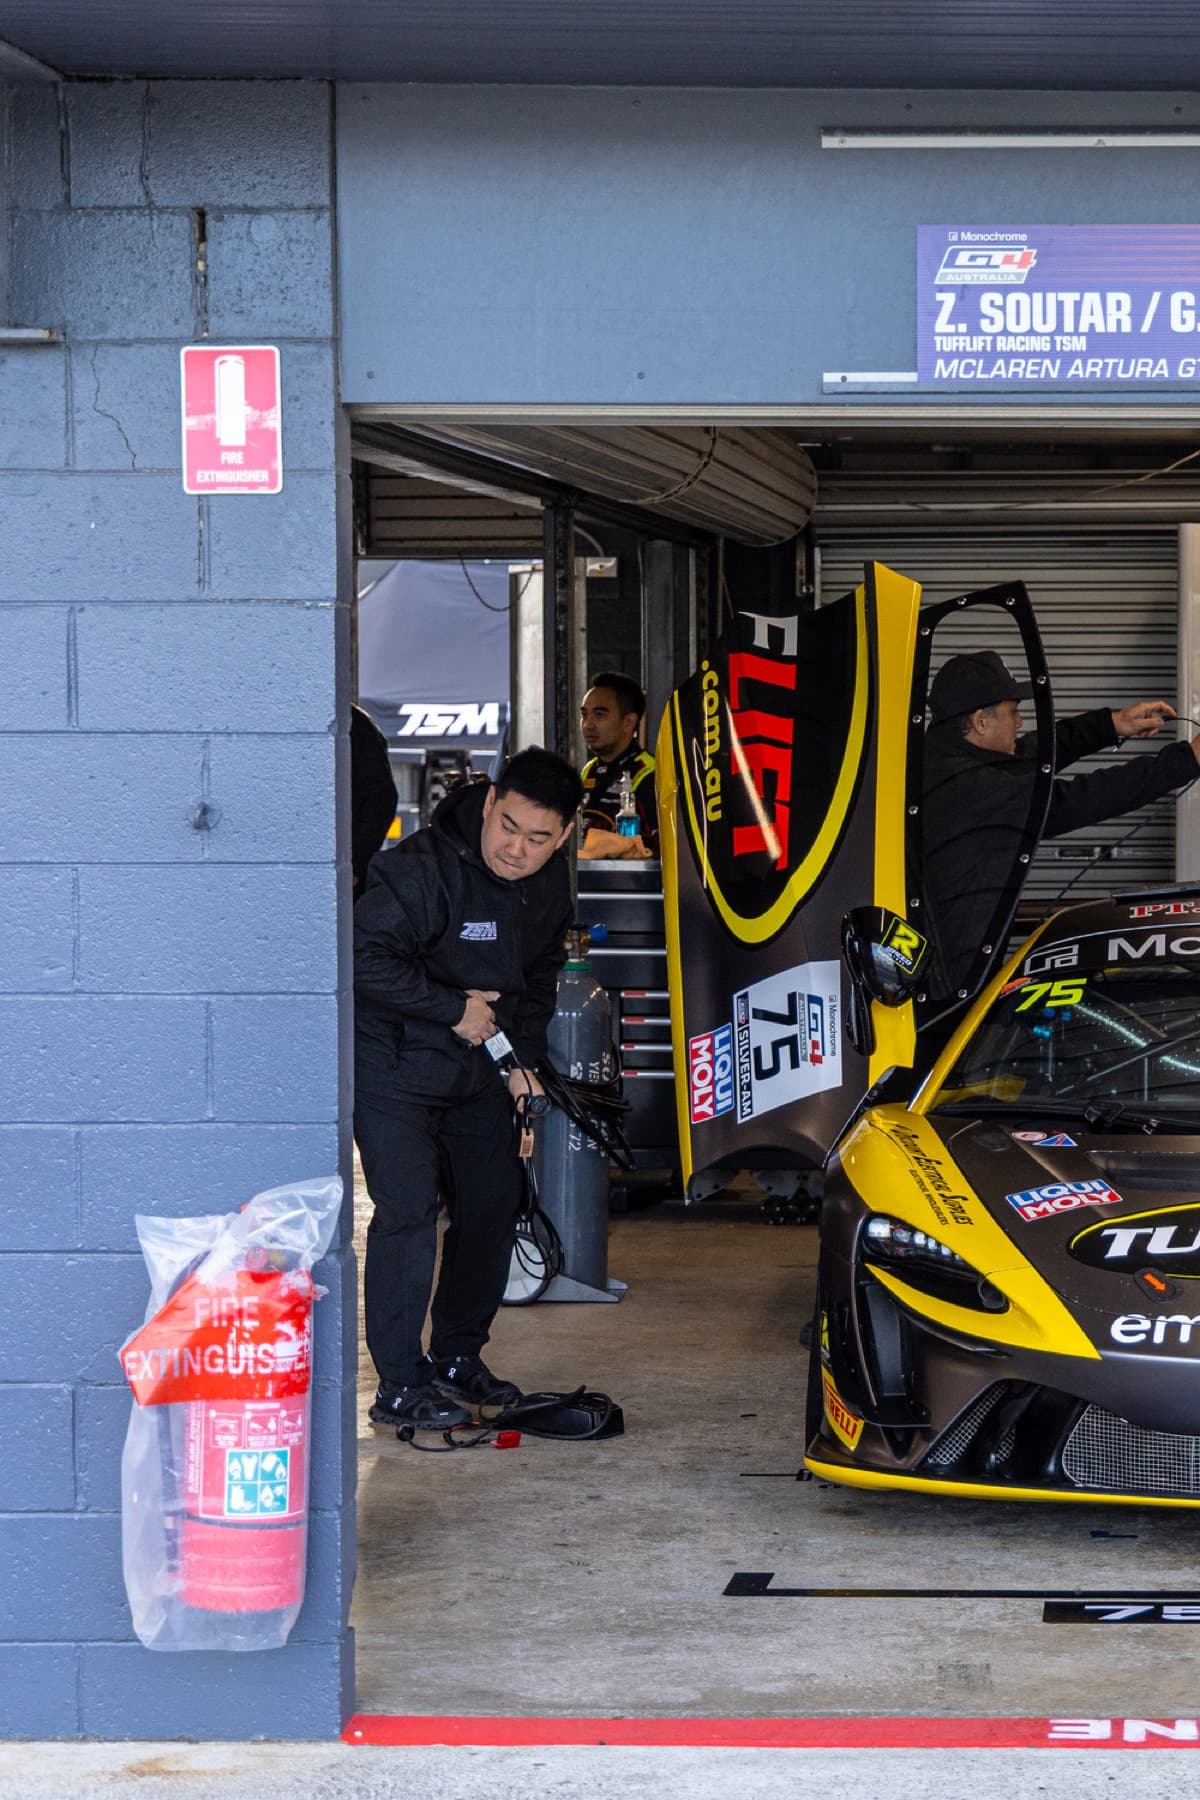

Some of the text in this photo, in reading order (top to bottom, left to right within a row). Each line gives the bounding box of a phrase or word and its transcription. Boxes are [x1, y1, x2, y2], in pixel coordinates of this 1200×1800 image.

[960, 231, 1028, 241] Monochrome
[954, 249, 1038, 269] GT4
[946, 273, 1017, 281] AUSTRALIA
[934, 292, 967, 333] Z.
[979, 291, 1132, 333] SOUTAR
[933, 335, 1087, 352] TUFFLIFT RACING TSM
[933, 359, 1060, 379] MCLAREN
[1067, 358, 1170, 379] ARTURA
[220, 451, 244, 464] FIRE
[196, 469, 270, 483] EXTINGUISHER
[397, 702, 500, 737] TSM
[701, 660, 722, 823] .com.au
[1014, 977, 1088, 1013] 75
[751, 990, 800, 1081] 75
[828, 1003, 837, 1057] Monochrome
[692, 1039, 714, 1116] MOLY
[713, 1029, 732, 1111] LIQUI
[737, 1029, 750, 1117] SILVER-AM
[1012, 1182, 1105, 1206] LIQUI
[1022, 1190, 1112, 1218] MOLY
[194, 1296, 260, 1329] FIRE
